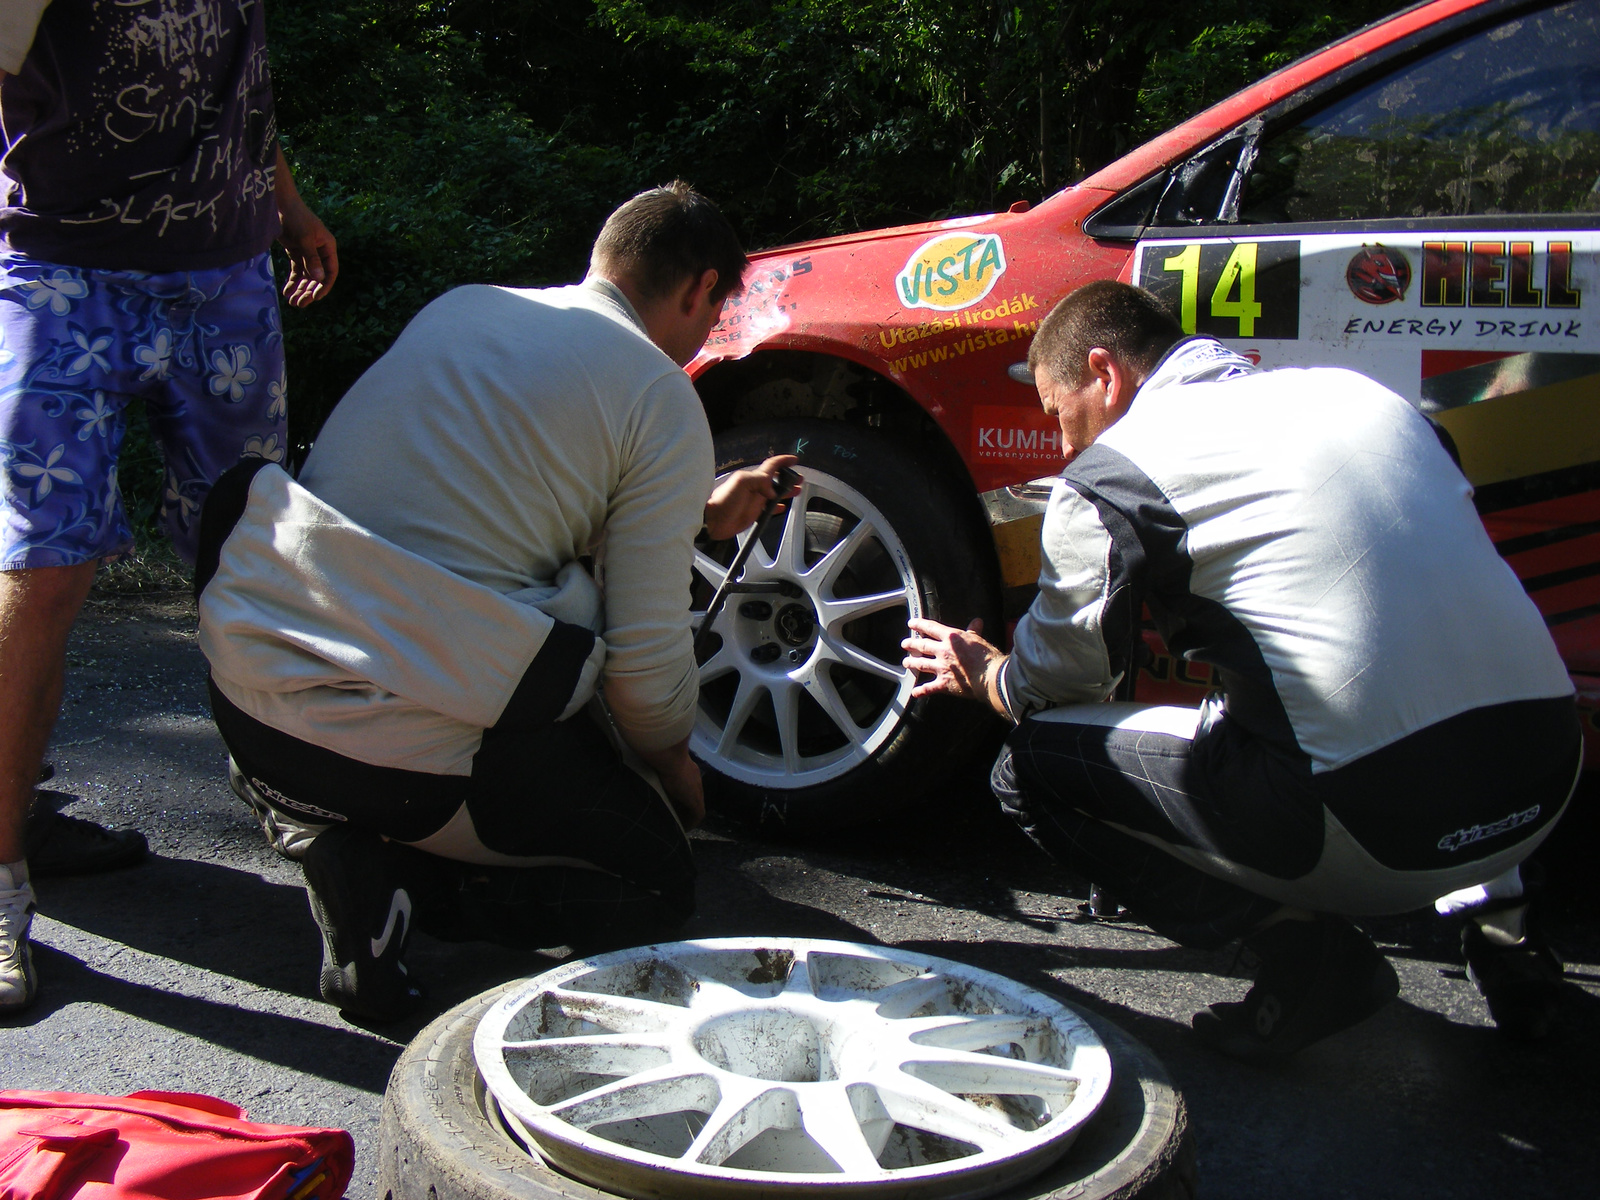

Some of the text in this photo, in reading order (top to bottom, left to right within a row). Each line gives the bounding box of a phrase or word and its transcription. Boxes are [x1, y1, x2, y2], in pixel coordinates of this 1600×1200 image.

[902, 238, 1001, 305] VISTA
[1163, 243, 1262, 337] 14
[1420, 240, 1581, 308] HELL
[879, 293, 1039, 349] Utazási Irodák
[888, 318, 1044, 375] www.vista.hu
[1343, 318, 1582, 338] ENERGY DRINK
[796, 438, 809, 454] K
[979, 427, 1063, 450] KUMH
